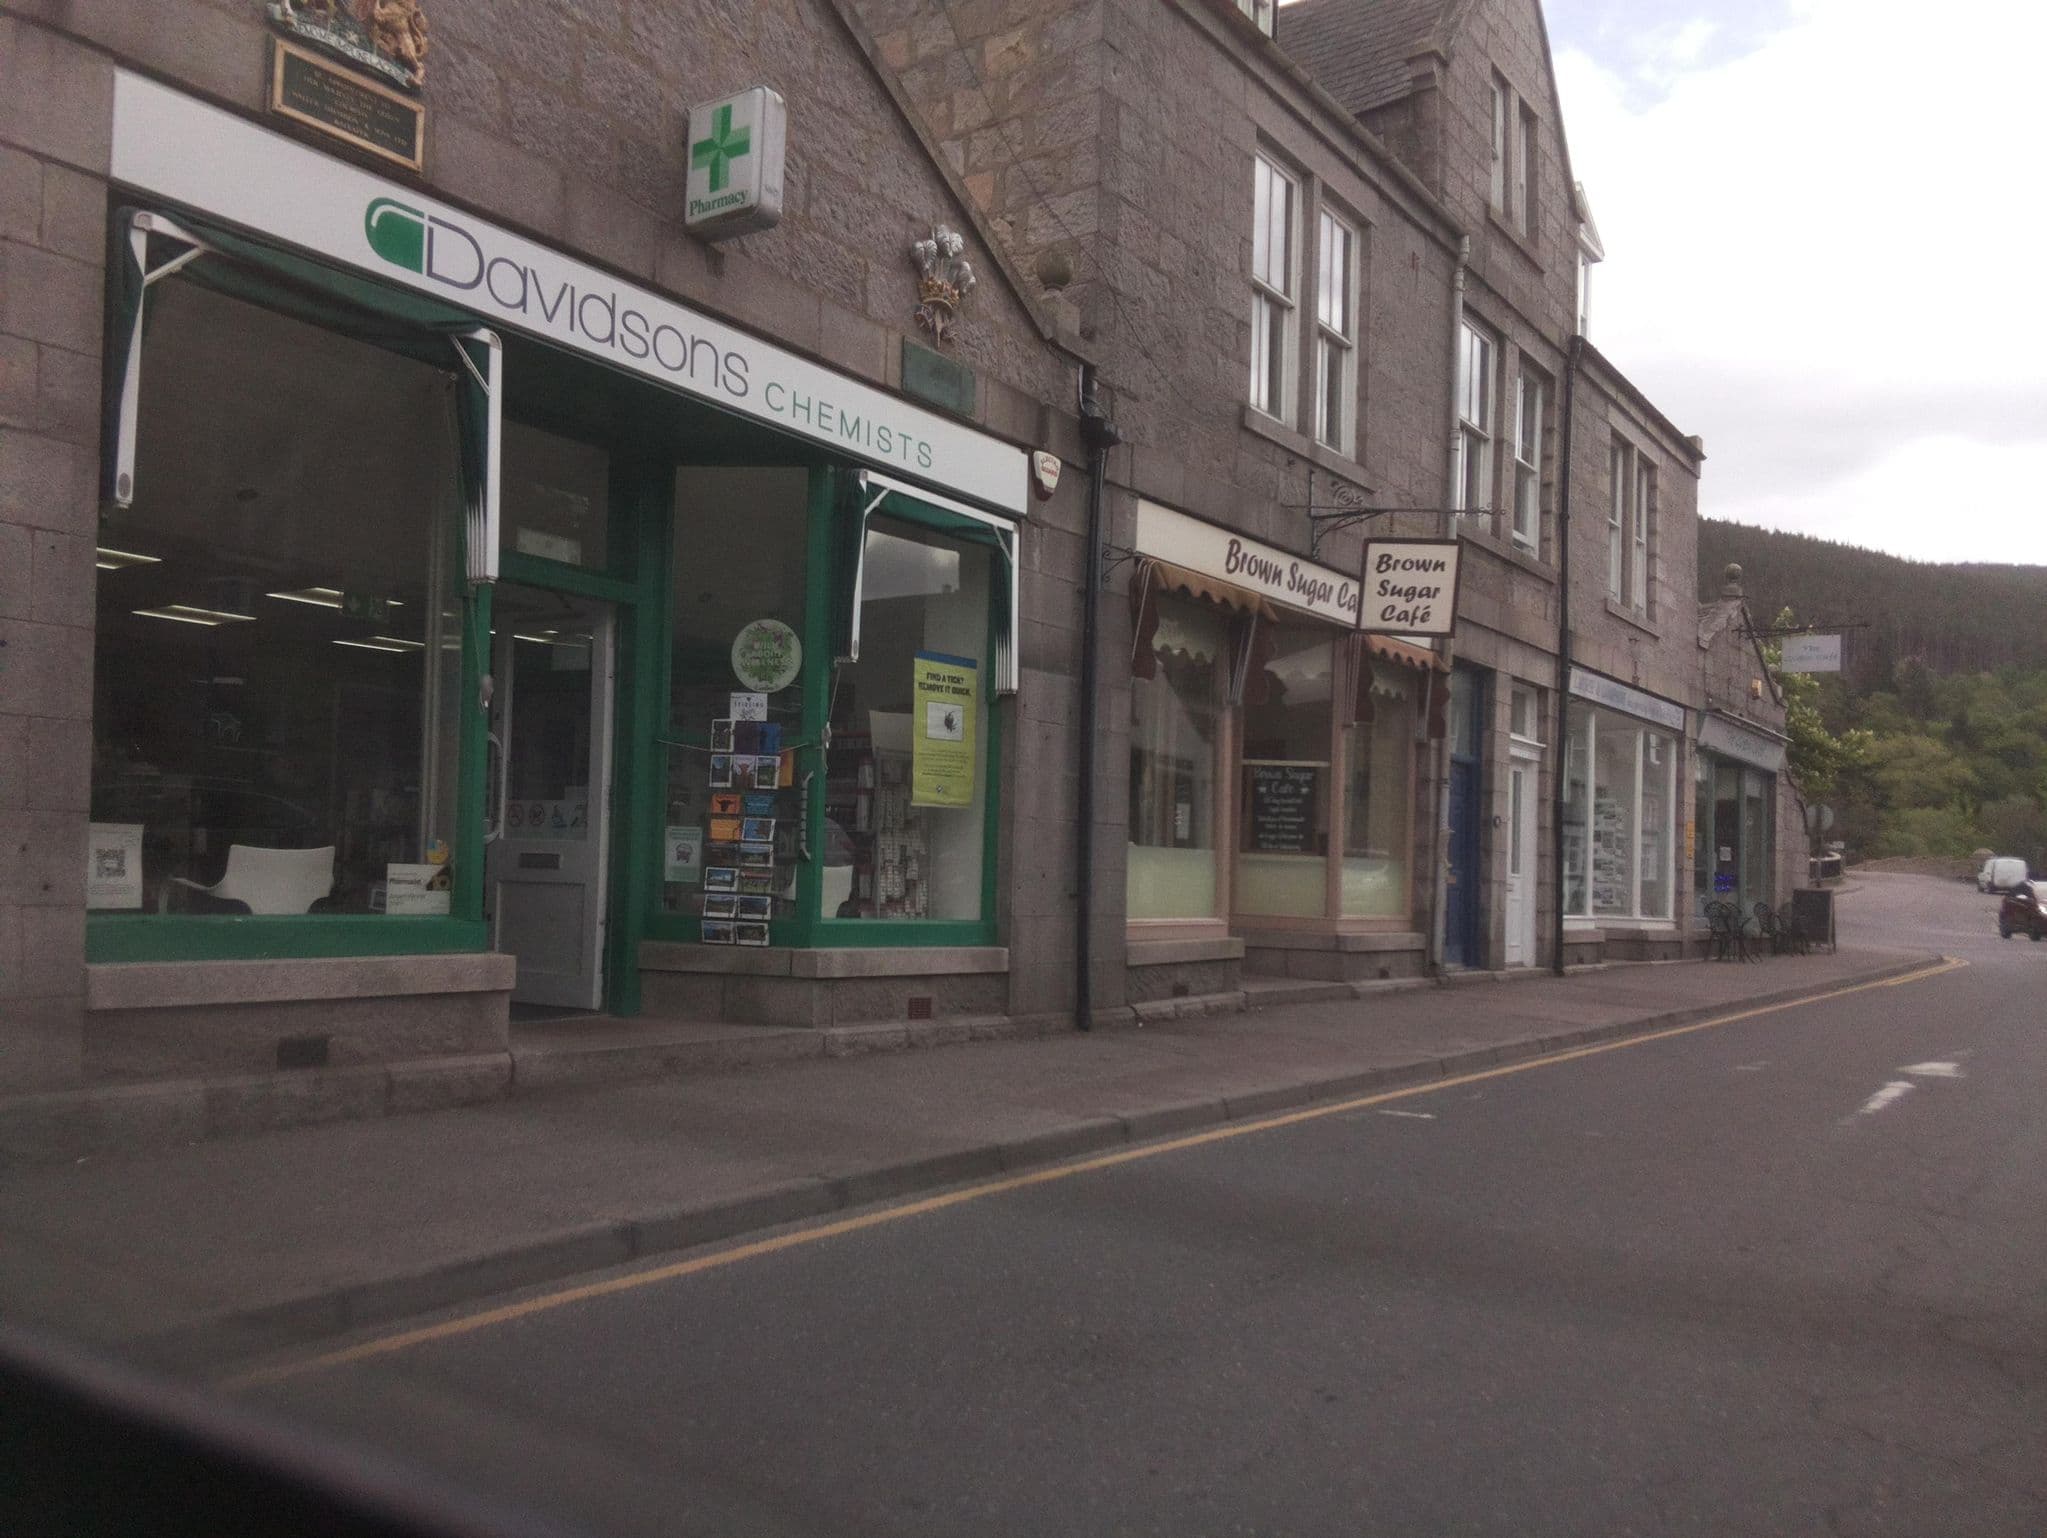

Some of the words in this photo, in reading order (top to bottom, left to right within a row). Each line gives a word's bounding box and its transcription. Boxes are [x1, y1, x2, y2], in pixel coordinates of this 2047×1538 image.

[689, 189, 748, 217] Pharmacy
[427, 214, 749, 397] Davidsons
[764, 381, 933, 468] CHEMISTS
[1225, 538, 1283, 587] Brown
[1287, 562, 1334, 606] Sugar
[1337, 582, 1360, 615] Ca
[1375, 553, 1446, 574] Brown
[1377, 579, 1441, 603] Sugar
[1380, 604, 1432, 627] Café
